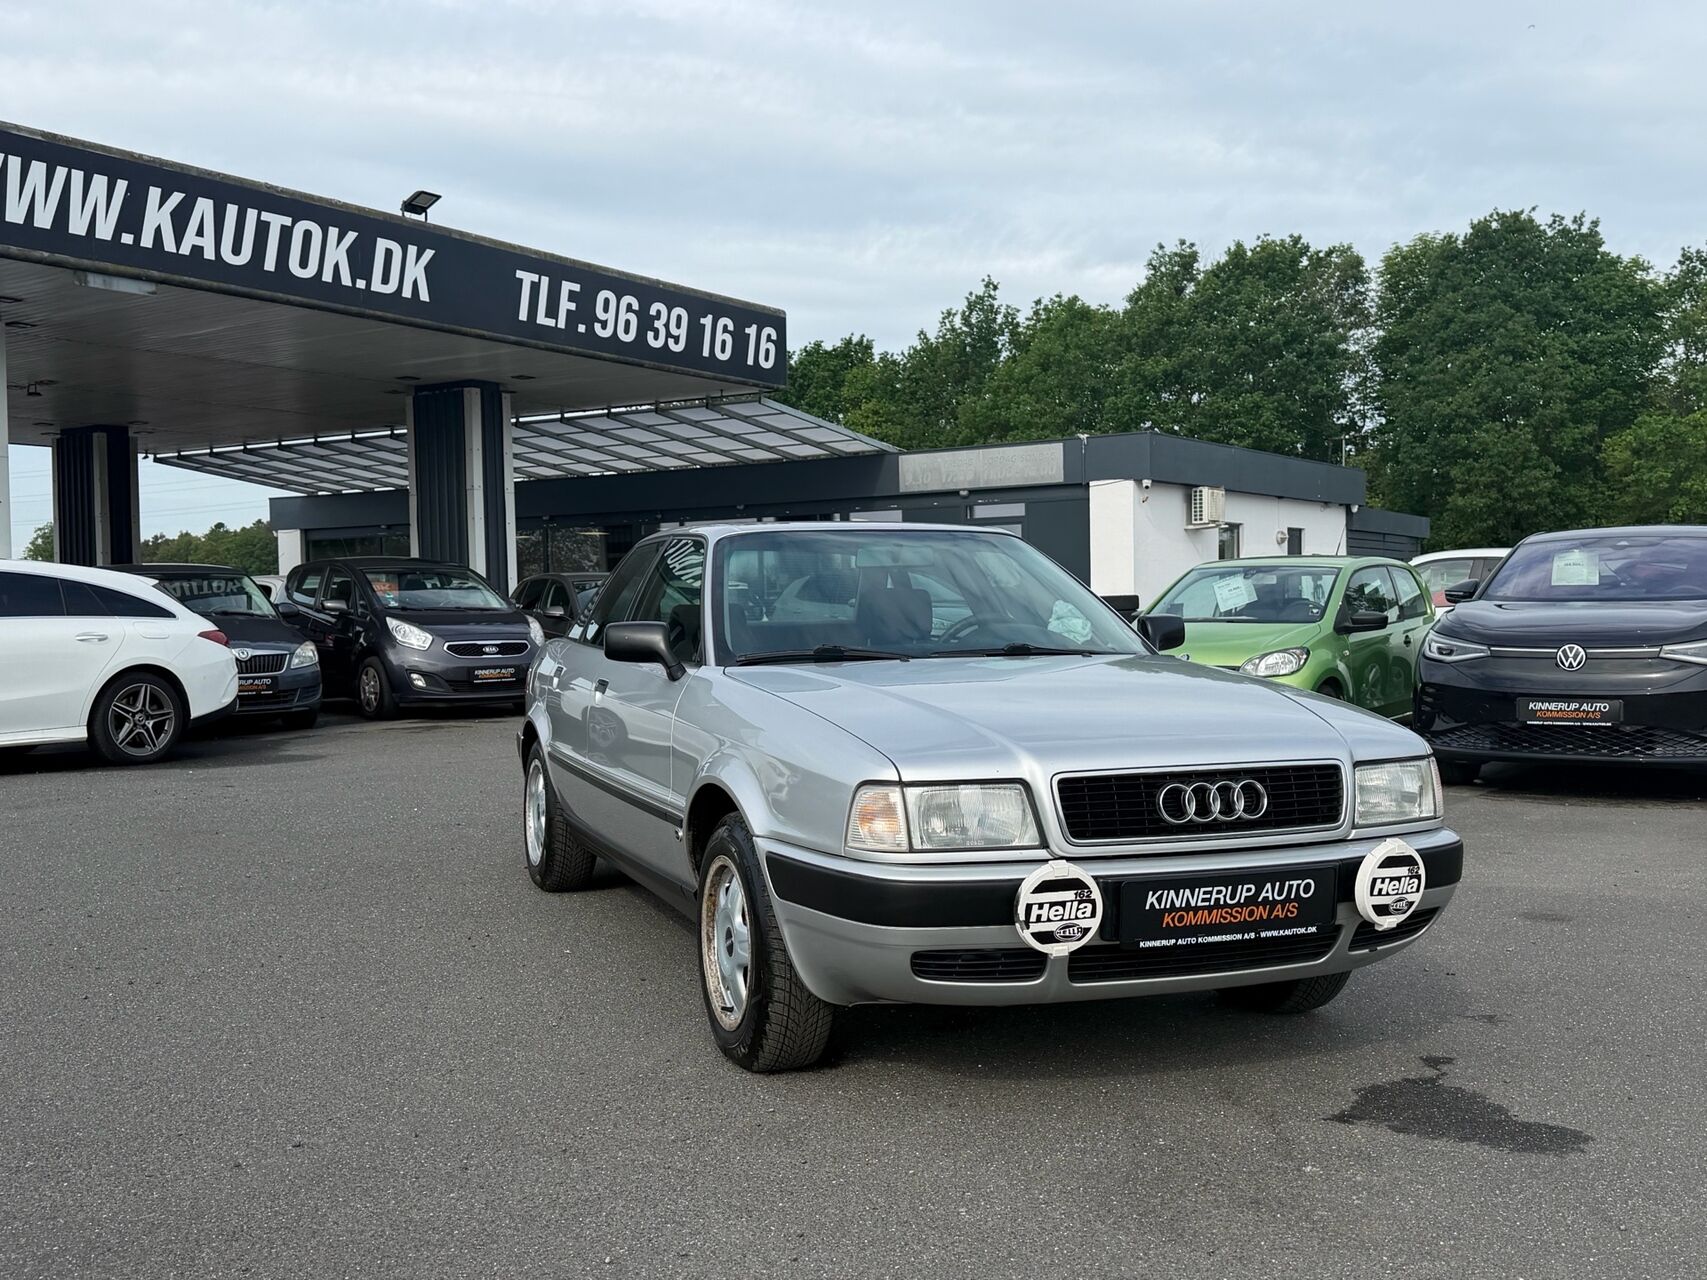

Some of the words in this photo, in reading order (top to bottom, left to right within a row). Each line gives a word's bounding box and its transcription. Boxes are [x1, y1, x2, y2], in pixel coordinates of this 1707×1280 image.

[0, 152, 436, 303] WW.KAUTOK.DK
[515, 269, 586, 333] TLF.
[593, 289, 640, 343] 96
[646, 302, 689, 352] 39
[700, 313, 735, 361] 16
[745, 323, 778, 370] 16
[1528, 702, 1579, 711] KINNERUP
[1580, 703, 1609, 712] AUTO
[1536, 711, 1585, 719] KOMMISSION
[1074, 890, 1093, 899] 162
[1145, 884, 1255, 910] KINNERUP
[1258, 879, 1315, 902] AUTO
[1373, 877, 1419, 895] Hella
[1029, 901, 1093, 922] Hella
[1162, 905, 1269, 928] KOMMISSION
[1271, 902, 1298, 919] A/S
[1139, 939, 1176, 948] KINNERUP
[1177, 937, 1196, 945] AUTO
[1198, 934, 1242, 943] KOMMISSION
[1243, 932, 1255, 940] A/S
[1260, 926, 1317, 938] WWW.KAUTOK.DK
